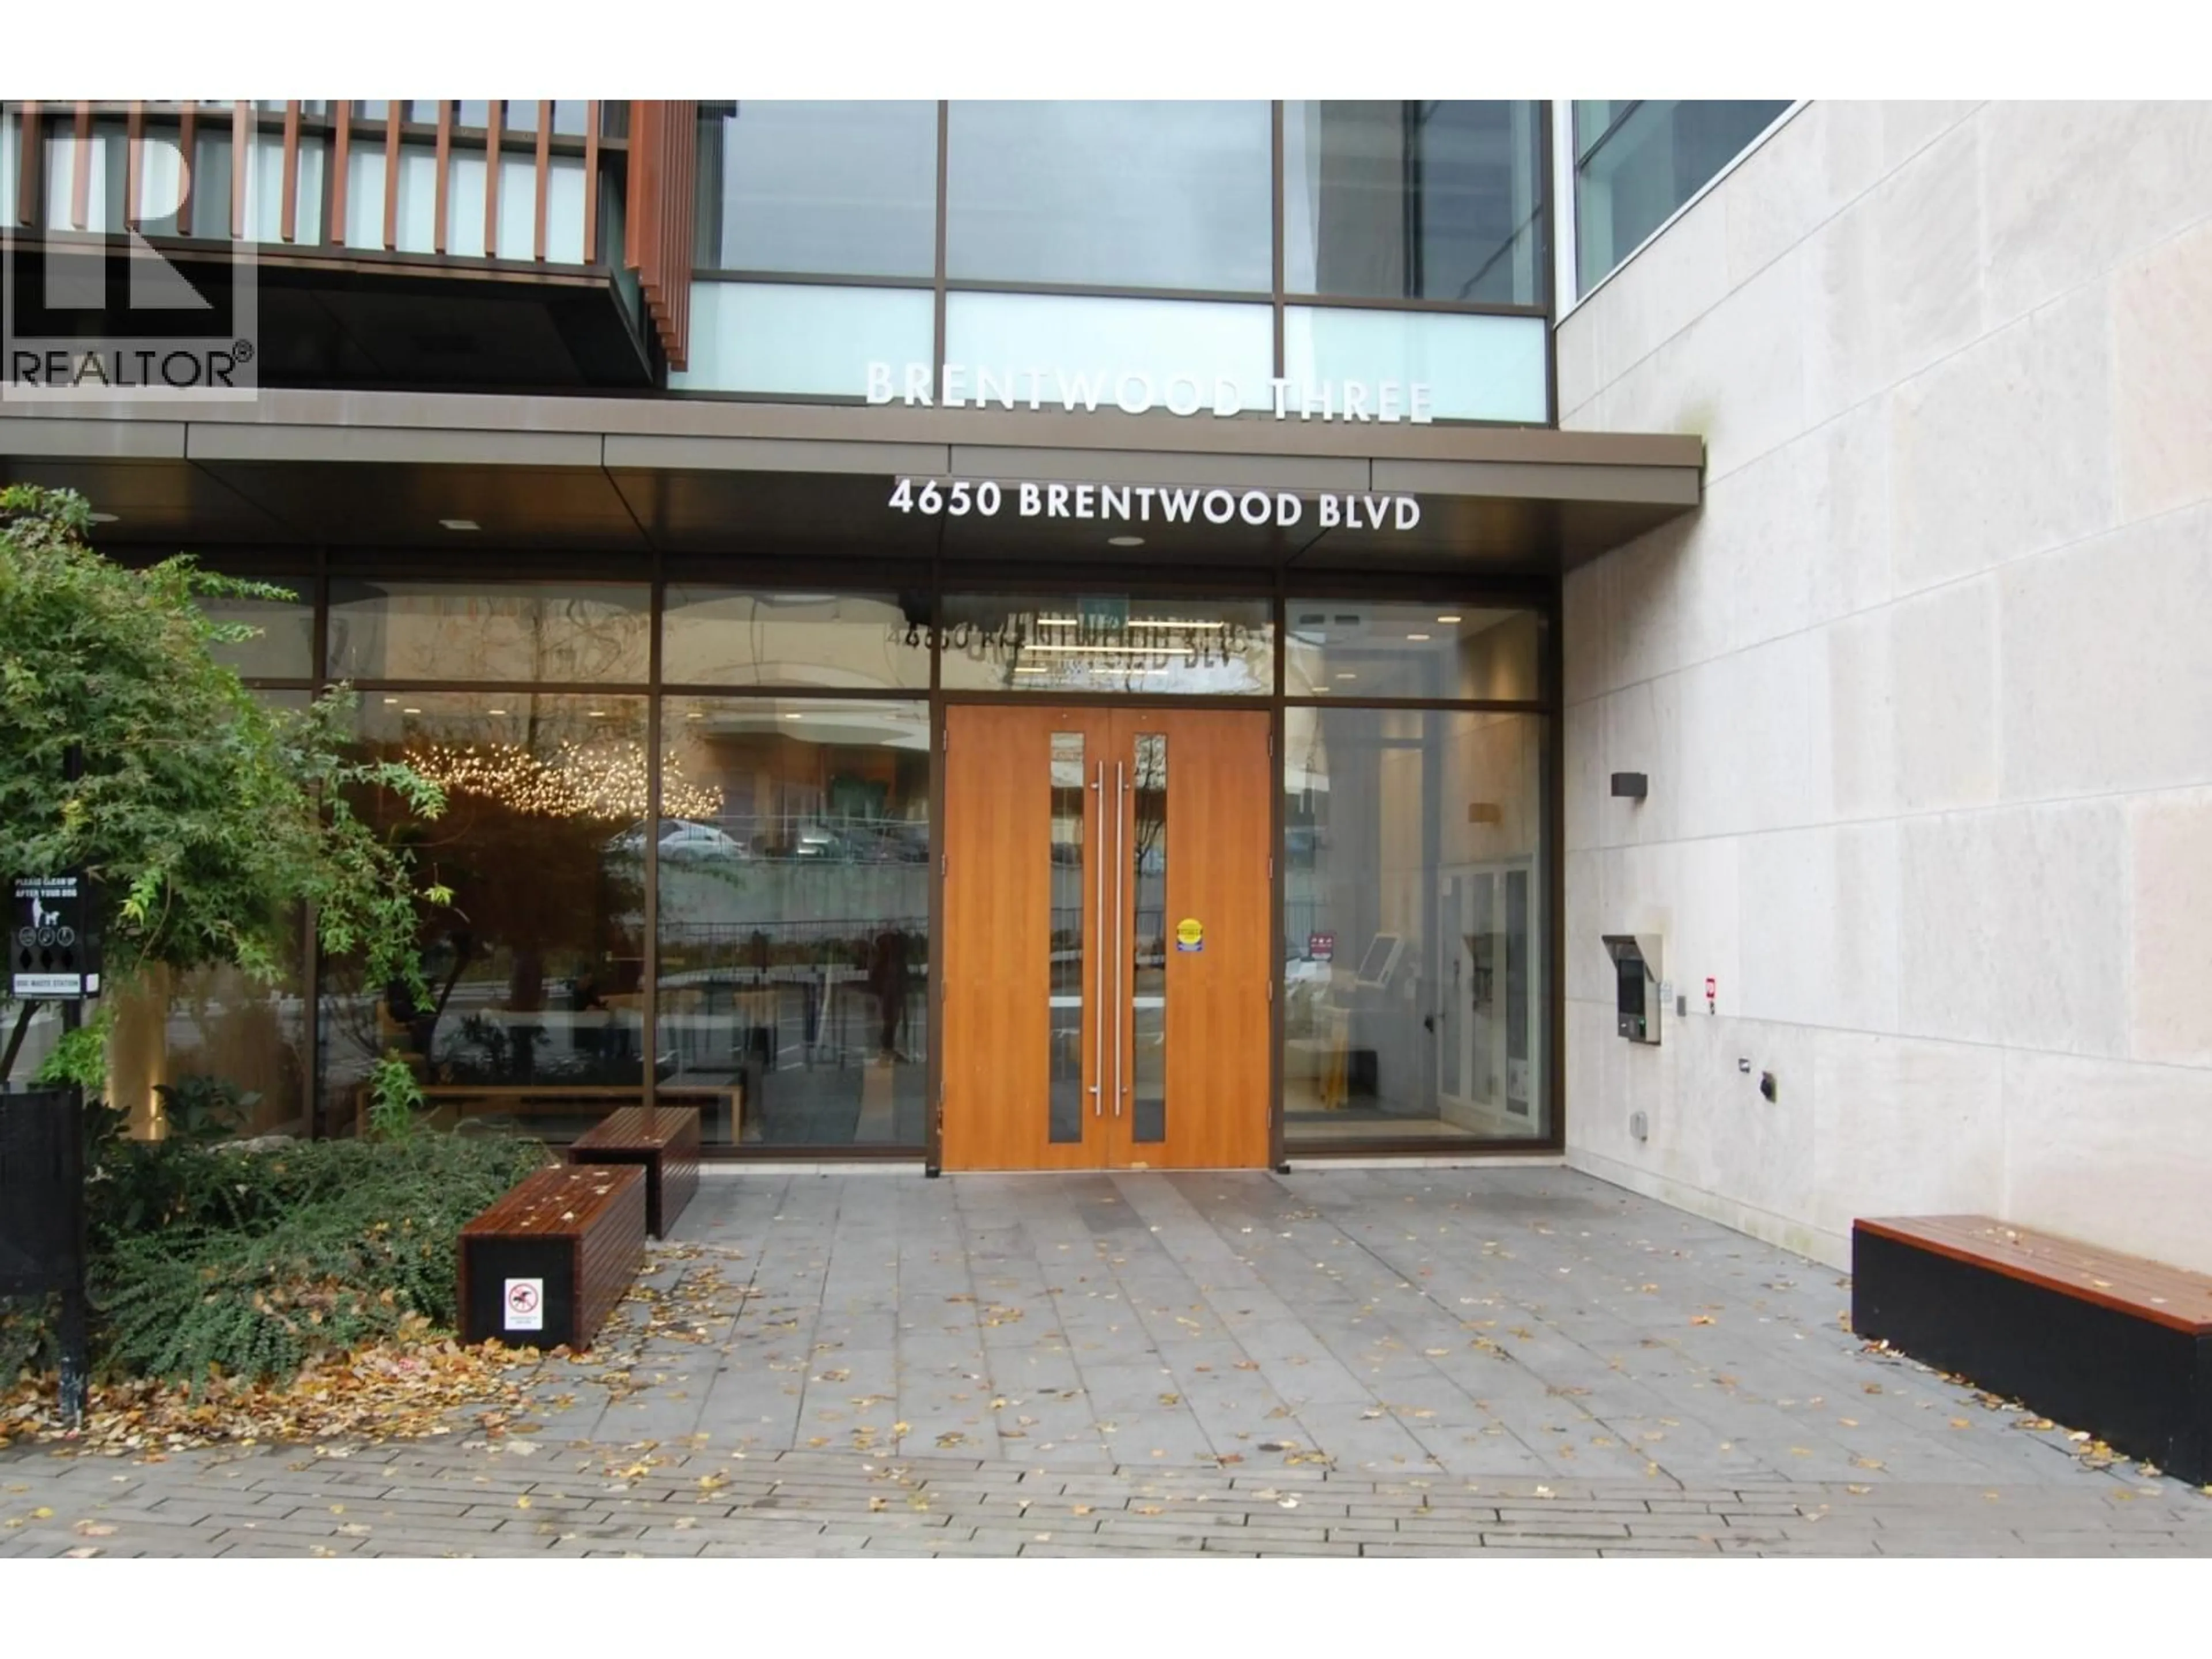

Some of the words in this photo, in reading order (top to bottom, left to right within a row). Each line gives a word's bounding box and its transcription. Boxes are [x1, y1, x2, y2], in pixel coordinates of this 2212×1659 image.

[866, 361, 1243, 416] BRENTWOOD
[1268, 377, 1434, 425] THREE
[888, 478, 1001, 516] 4650
[1019, 484, 1302, 527] BRENTWOOD
[1319, 493, 1421, 530] BLVD
